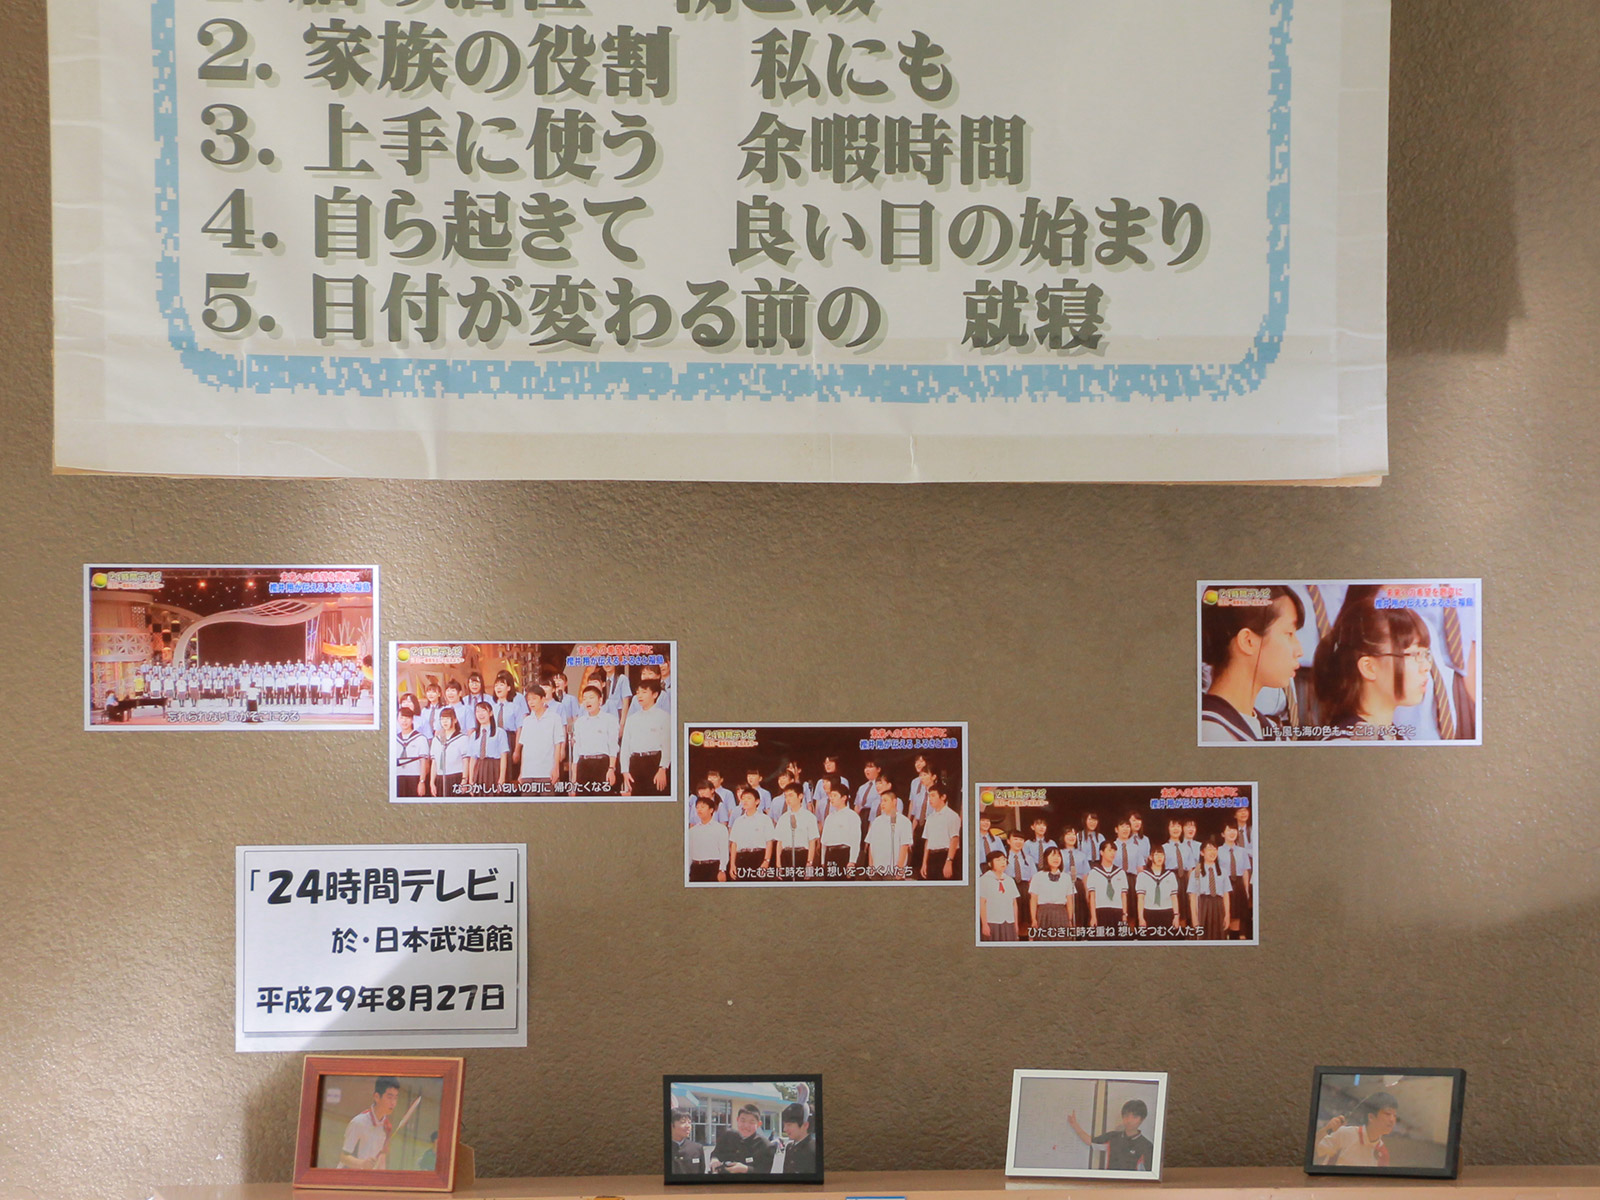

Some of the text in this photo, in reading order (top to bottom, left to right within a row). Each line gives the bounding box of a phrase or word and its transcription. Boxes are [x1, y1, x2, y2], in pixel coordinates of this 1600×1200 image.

[197, 17, 953, 102] 2. 家族の役割 私にも
[200, 103, 1027, 186] 3. 上手に使う 余暇時間
[201, 185, 1204, 267] 4. 自ら起きて 良い日の始まり
[202, 272, 1105, 351] 5. 日付が変わる前の 就寝
[554, 781, 612, 793] 帰りたくなる
[250, 867, 514, 905] 「24時間テレビ」
[332, 924, 514, 954] 於・日本武道館
[1028, 925, 1205, 938] ひたむきに時を重ね 想いをつむぐ人たち
[257, 984, 505, 1014] 平成29年8月27日
